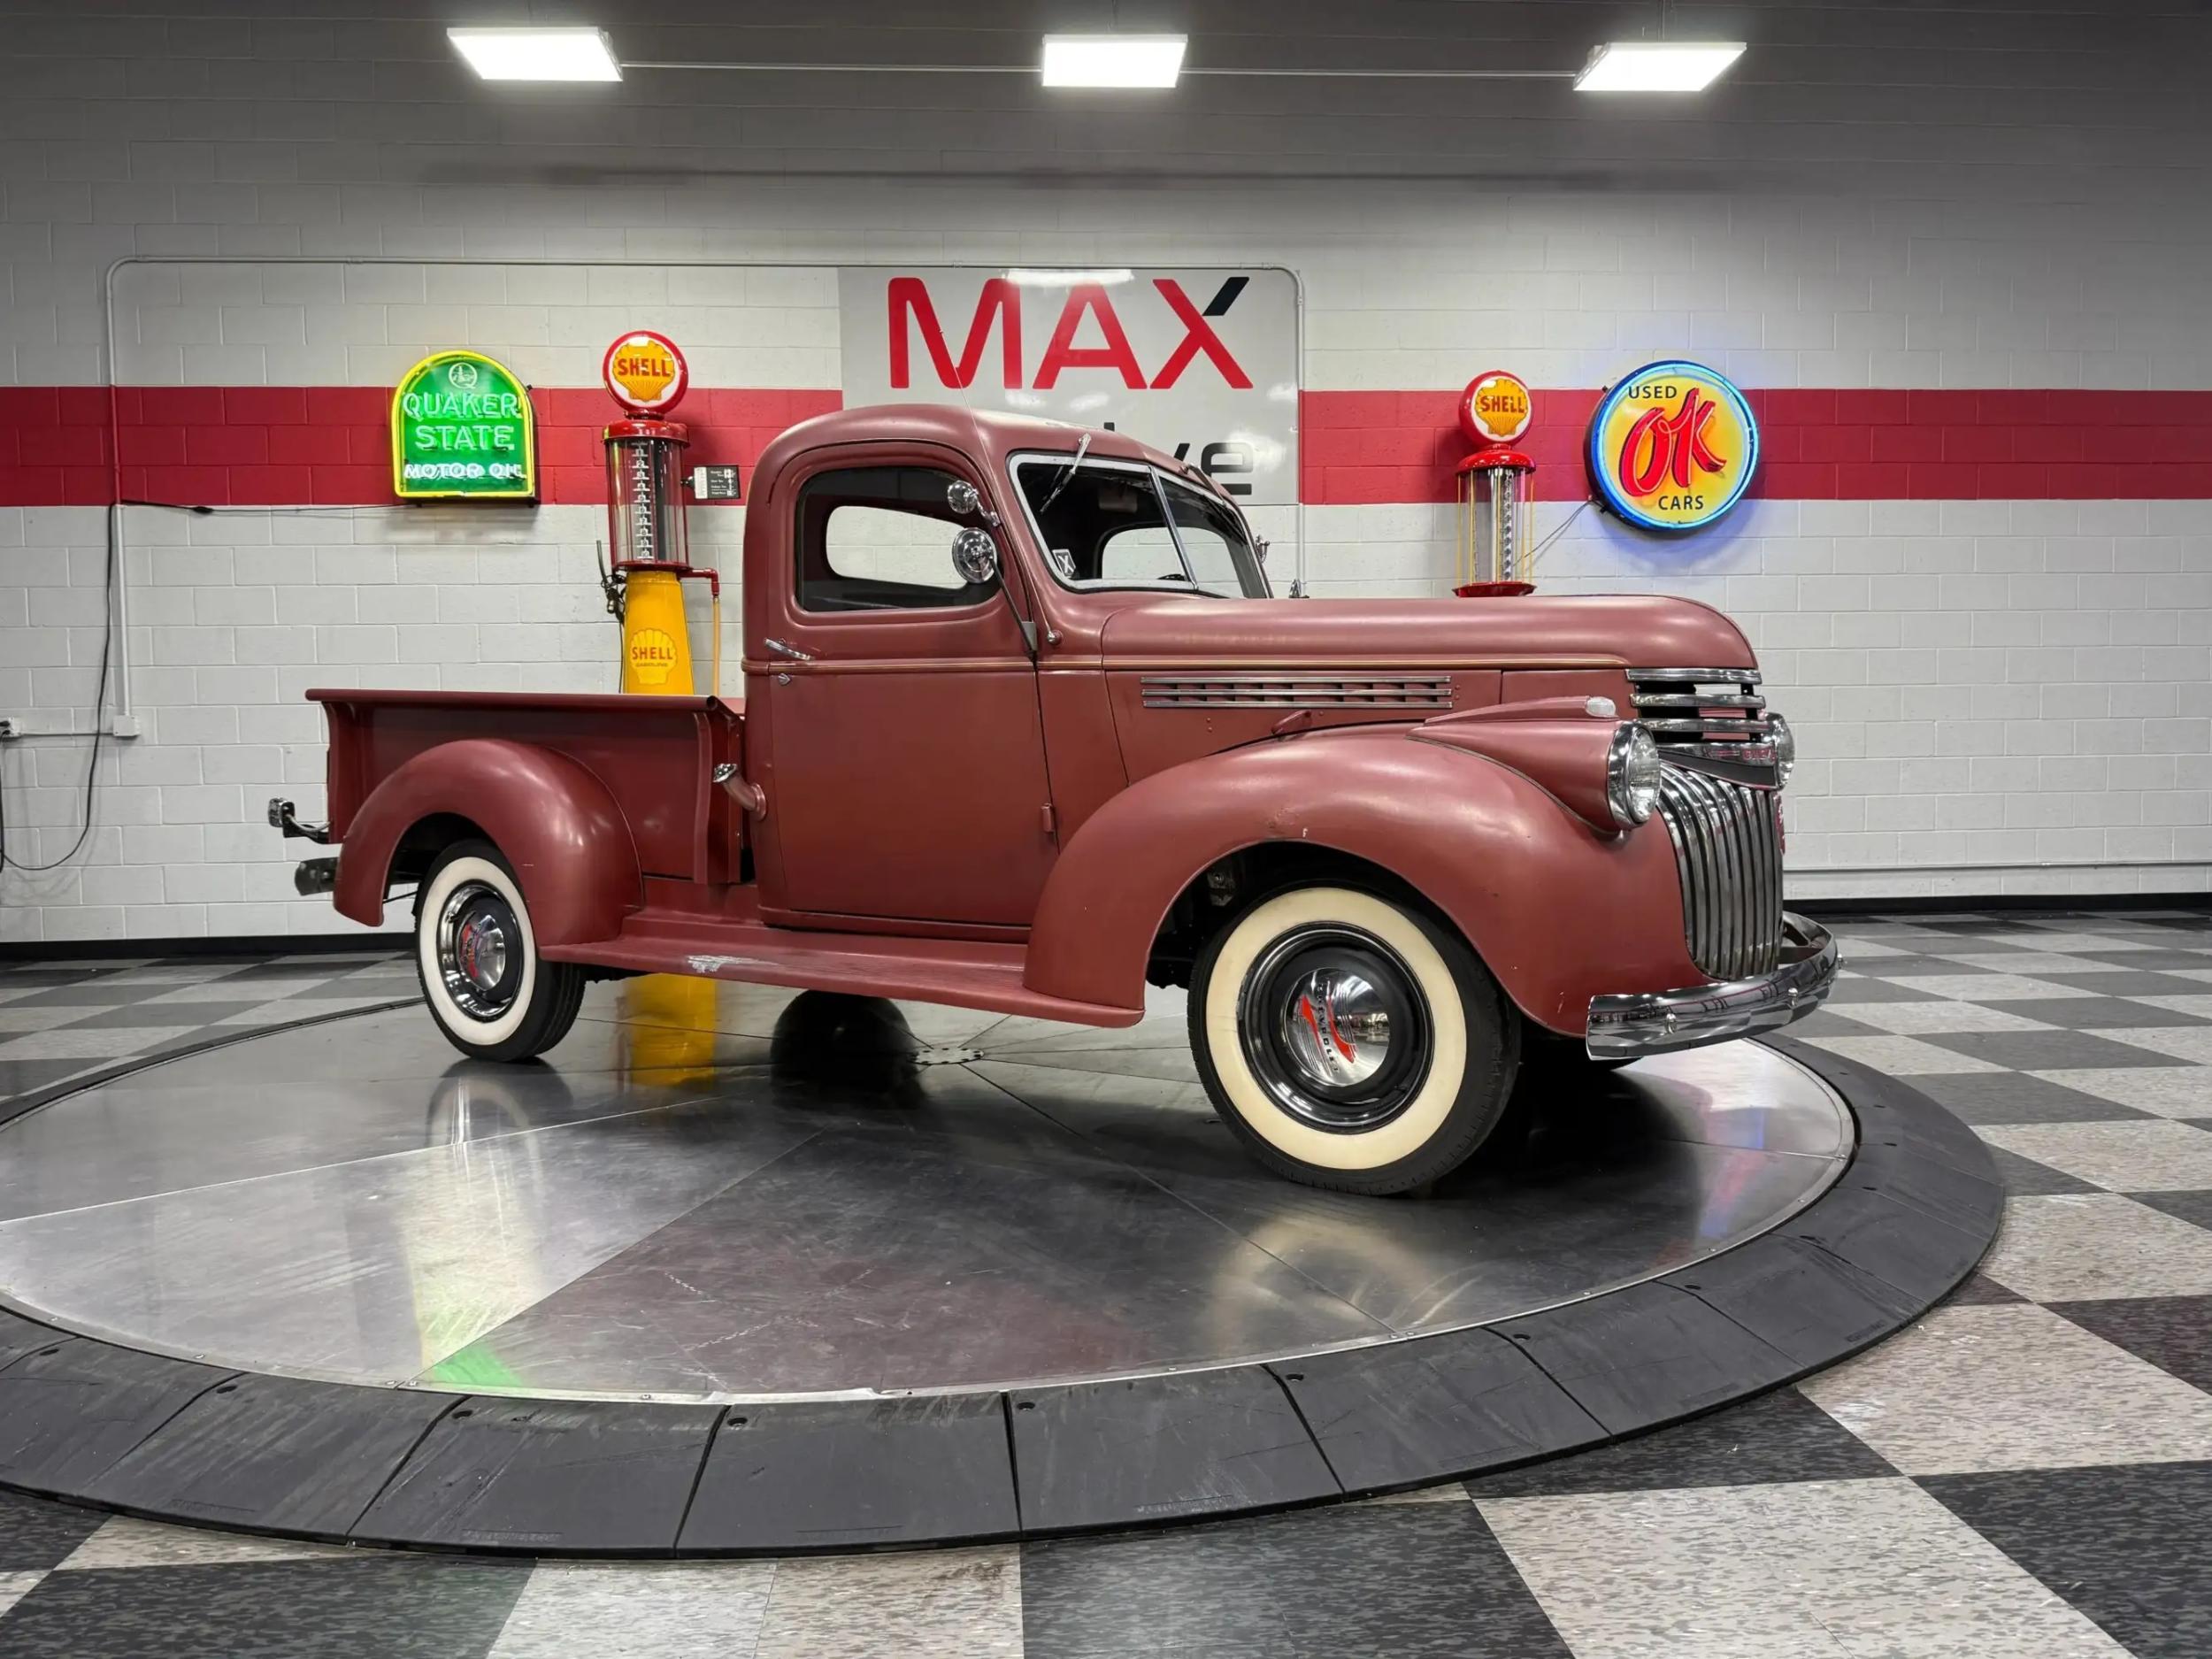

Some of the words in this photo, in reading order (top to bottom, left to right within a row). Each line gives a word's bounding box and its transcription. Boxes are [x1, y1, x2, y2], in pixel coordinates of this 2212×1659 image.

[887, 276, 1254, 389] MAX
[617, 357, 672, 378] SHELL
[1628, 385, 1678, 399] USED
[403, 391, 523, 422] QUAKER
[1479, 395, 1525, 413] SHELL
[415, 425, 516, 451] STATE
[1618, 387, 1727, 497] OK
[403, 463, 486, 480] MOTOR
[488, 463, 527, 480] OIL
[1658, 495, 1704, 511] CARS
[632, 646, 673, 660] SHELL
